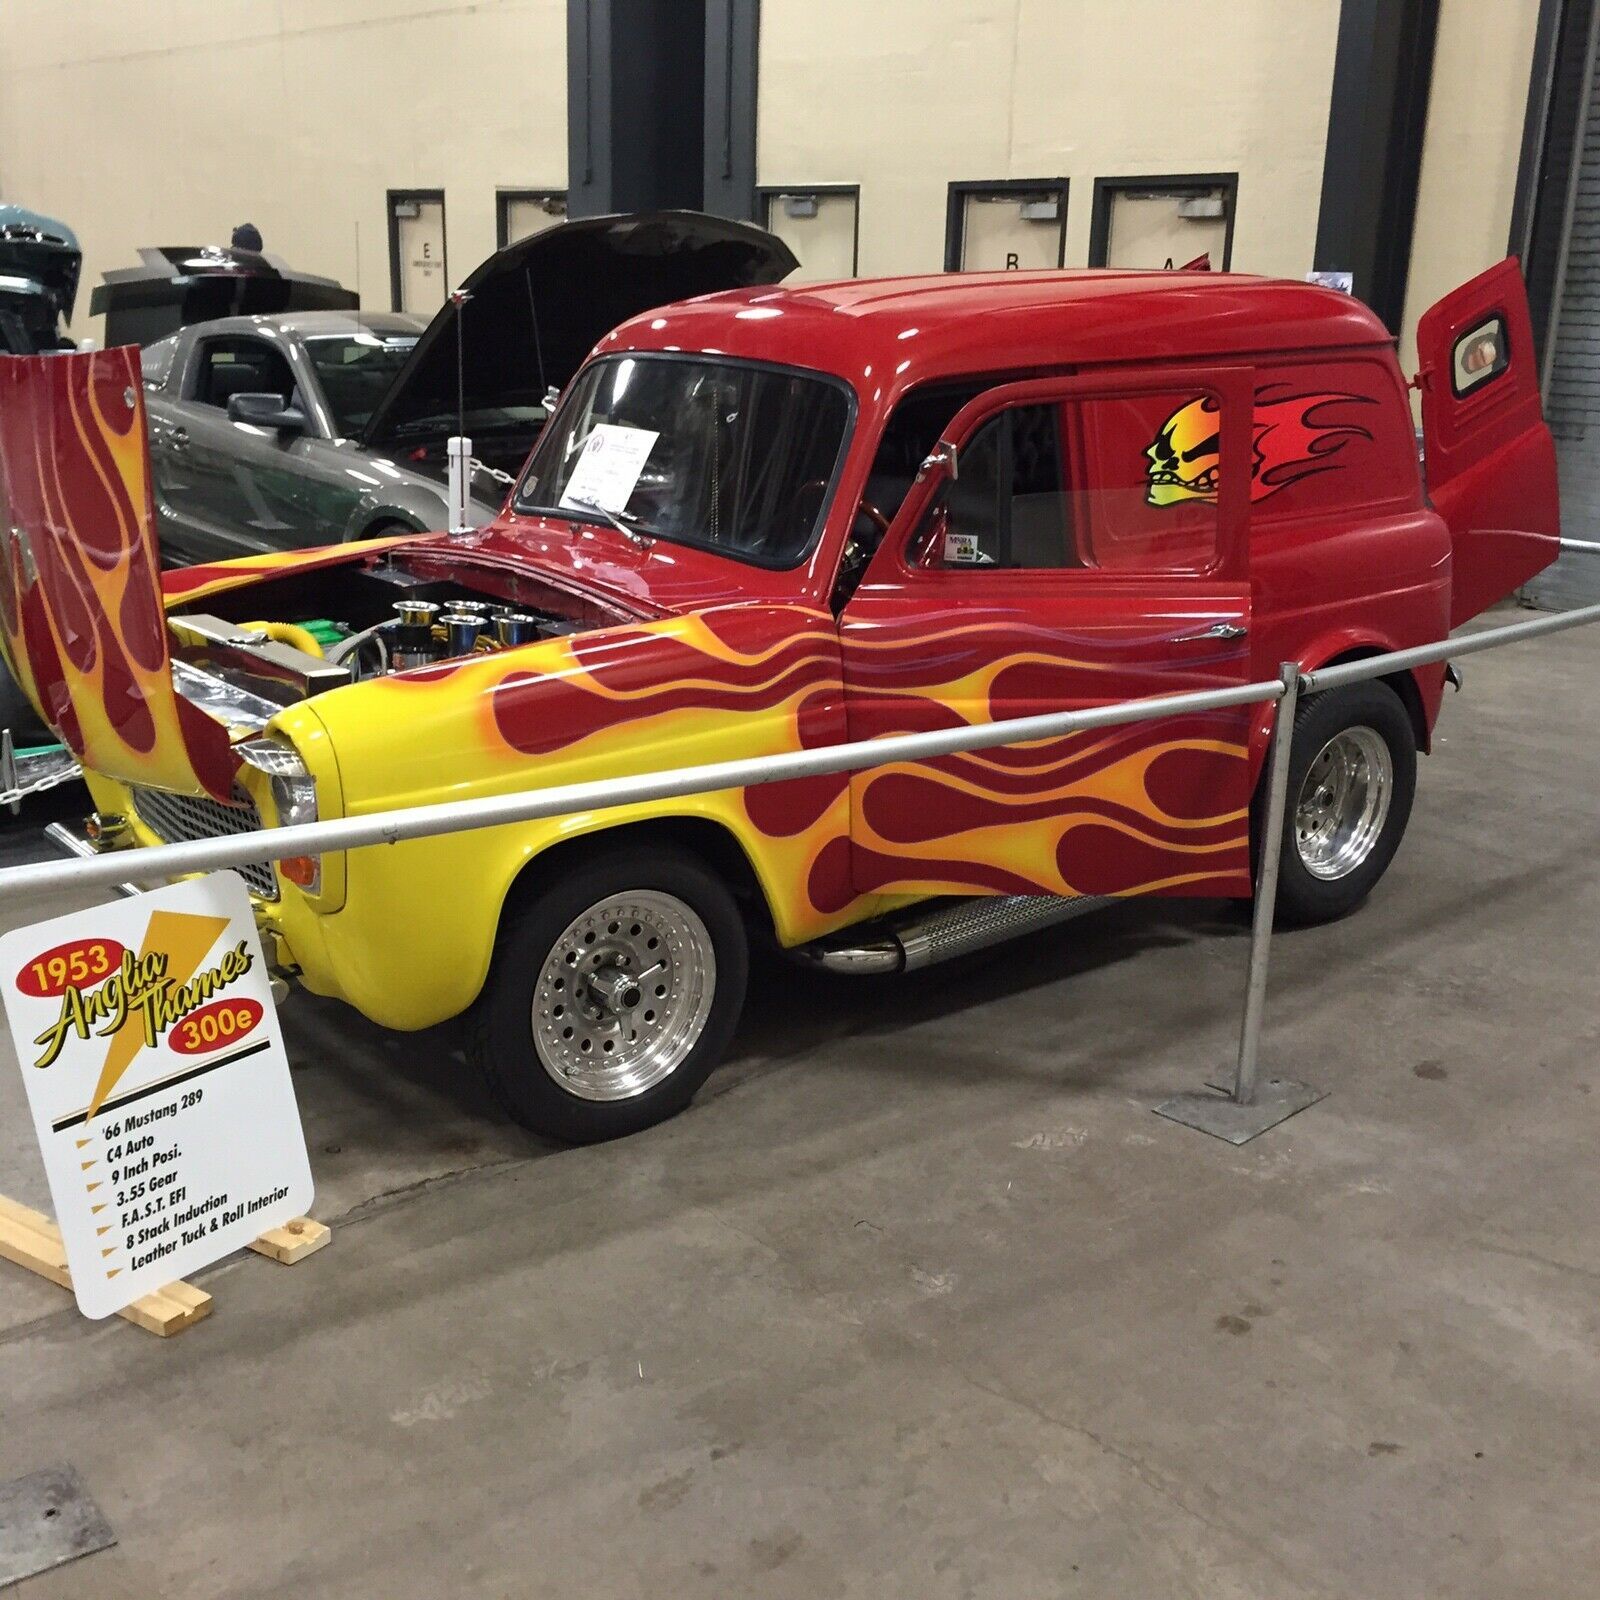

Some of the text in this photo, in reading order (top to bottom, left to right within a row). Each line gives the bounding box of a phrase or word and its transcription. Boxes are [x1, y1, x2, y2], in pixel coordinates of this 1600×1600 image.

[423, 242, 430, 258] E
[31, 945, 109, 991] 1953
[33, 949, 168, 1068] Anglia
[128, 940, 254, 1048] Thames
[182, 1008, 253, 1049] 300e
[102, 1088, 203, 1141] '66 Mustang 289
[107, 1135, 154, 1163] C4 Auto
[112, 1143, 182, 1185] 9 Inch Posi.
[116, 1171, 178, 1207] 3.55 Gear
[121, 1186, 187, 1228] F.A.S.T. EFI
[126, 1193, 228, 1250] 8 Stack Induction
[131, 1186, 289, 1271] Leather Tuck & Roll Interior
